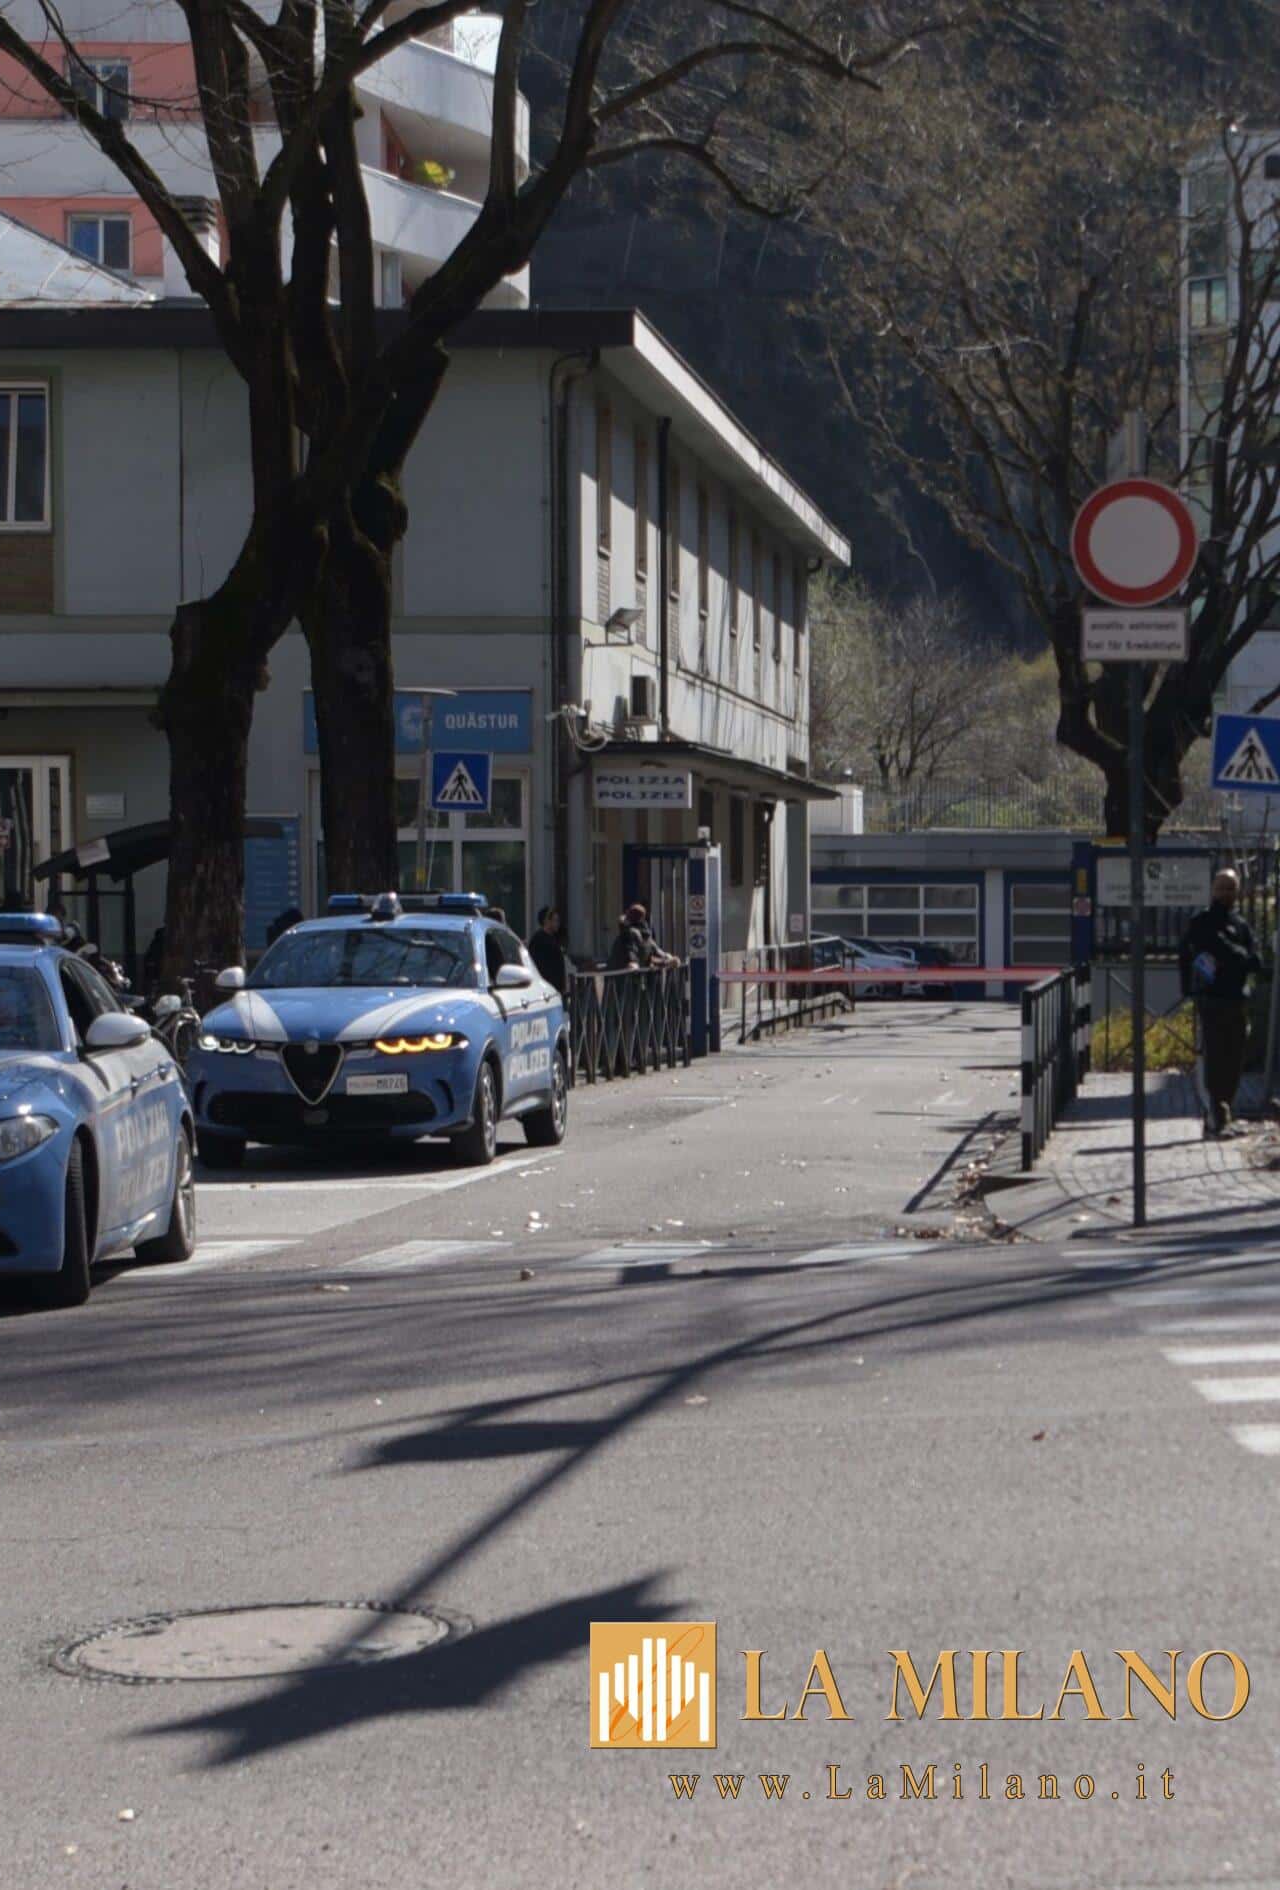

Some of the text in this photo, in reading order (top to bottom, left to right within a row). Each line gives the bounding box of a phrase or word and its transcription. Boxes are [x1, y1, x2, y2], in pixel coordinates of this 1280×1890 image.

[444, 710, 519, 729] QUÄSTUR
[596, 775, 685, 785] POLIZIA
[597, 791, 684, 800] POLIZEI
[115, 1101, 170, 1161] POLIZIA
